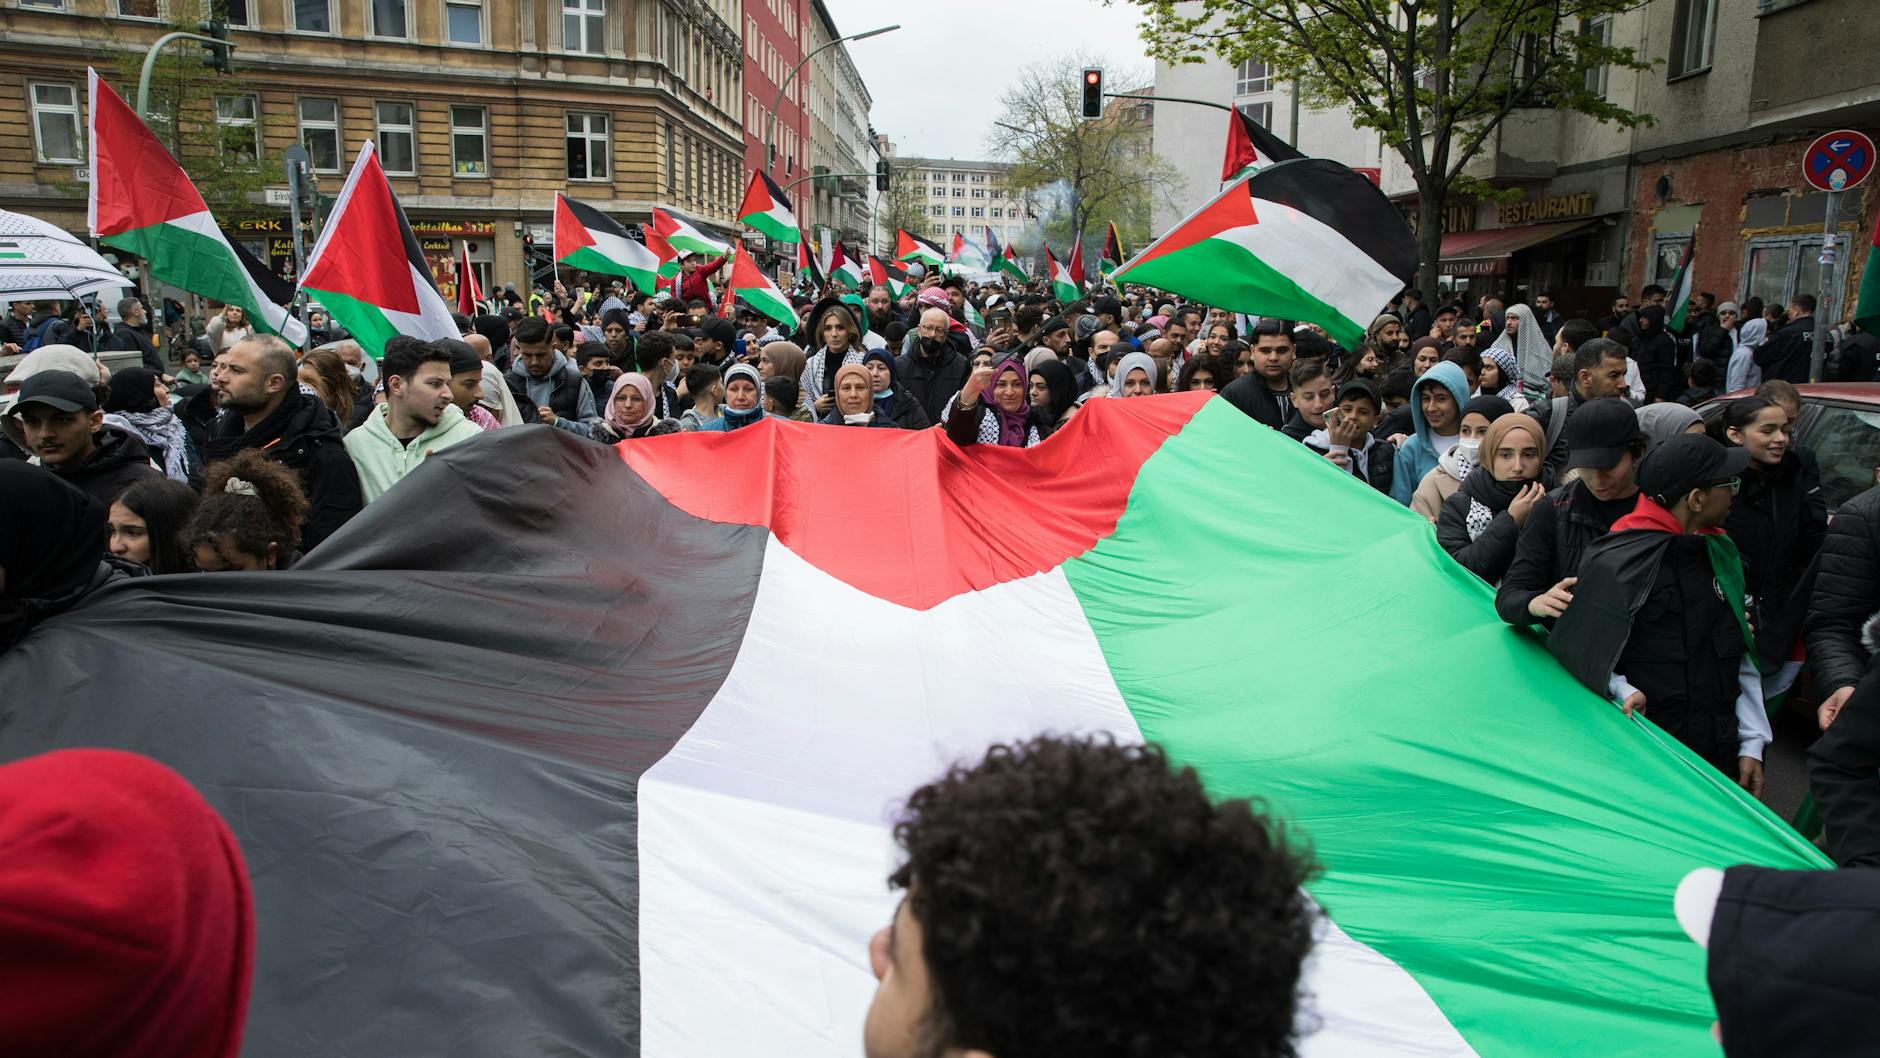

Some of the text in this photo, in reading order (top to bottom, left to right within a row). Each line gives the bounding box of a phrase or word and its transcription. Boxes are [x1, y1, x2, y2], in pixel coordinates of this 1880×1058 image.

[274, 191, 291, 200] Erkst
[1499, 193, 1594, 224] RESTAURANT
[411, 222, 463, 233] ocktailbar
[274, 239, 295, 249] Kalt
[1443, 261, 1497, 275] RESTAURANT
